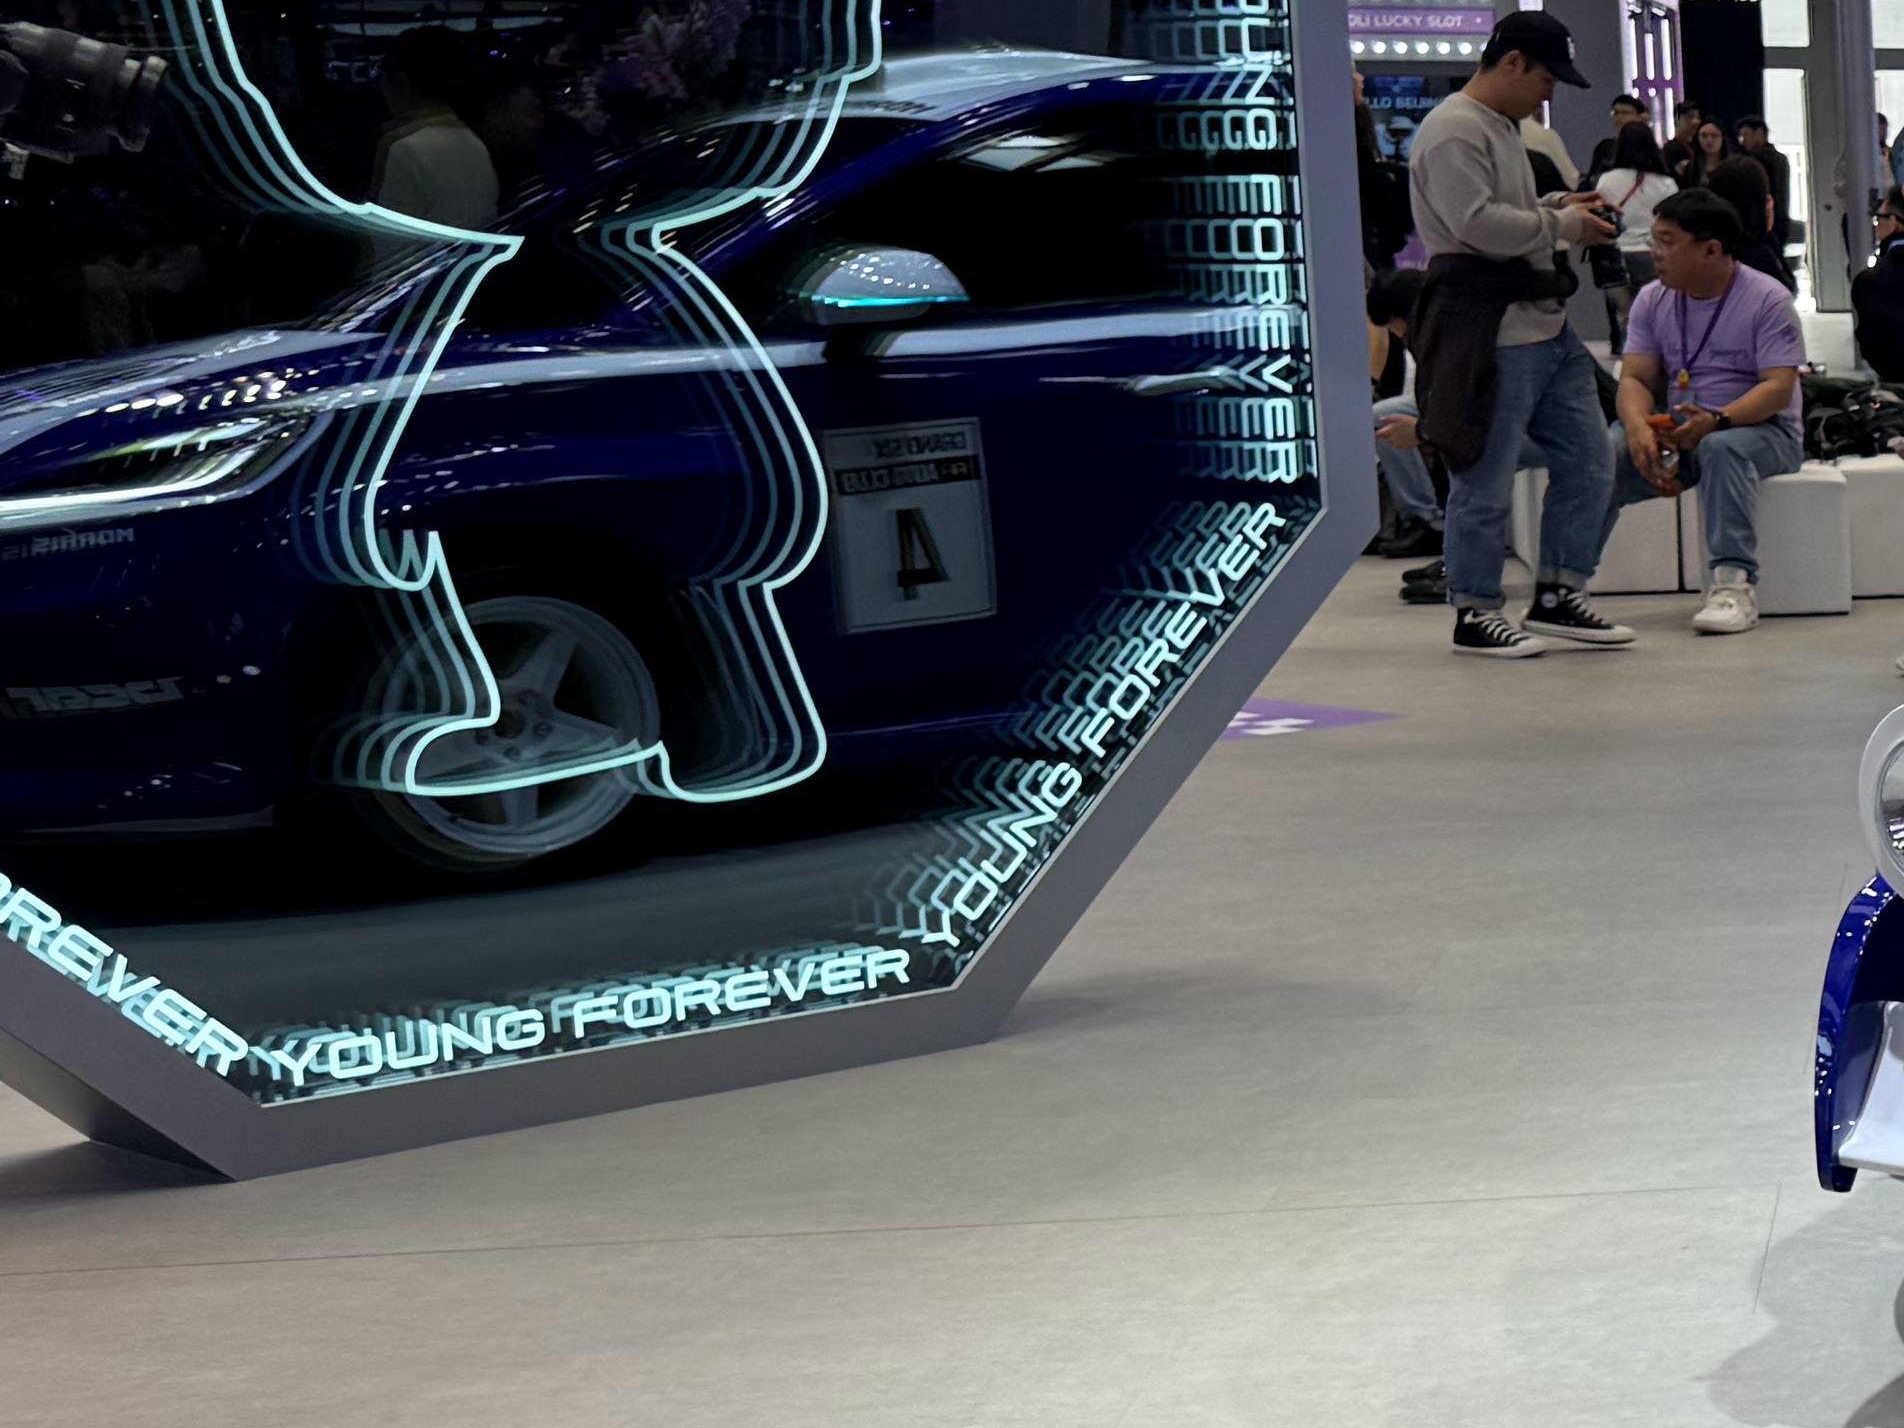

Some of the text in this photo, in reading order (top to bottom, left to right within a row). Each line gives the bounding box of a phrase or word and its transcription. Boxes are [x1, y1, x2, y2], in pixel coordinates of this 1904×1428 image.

[1249, 173, 1296, 484] FOREVER
[921, 762, 1082, 947] YOUNG
[1081, 502, 1286, 759] FOREVER
[0, 877, 249, 1077] REVER
[273, 948, 911, 1086] YOUNG FOREVER
